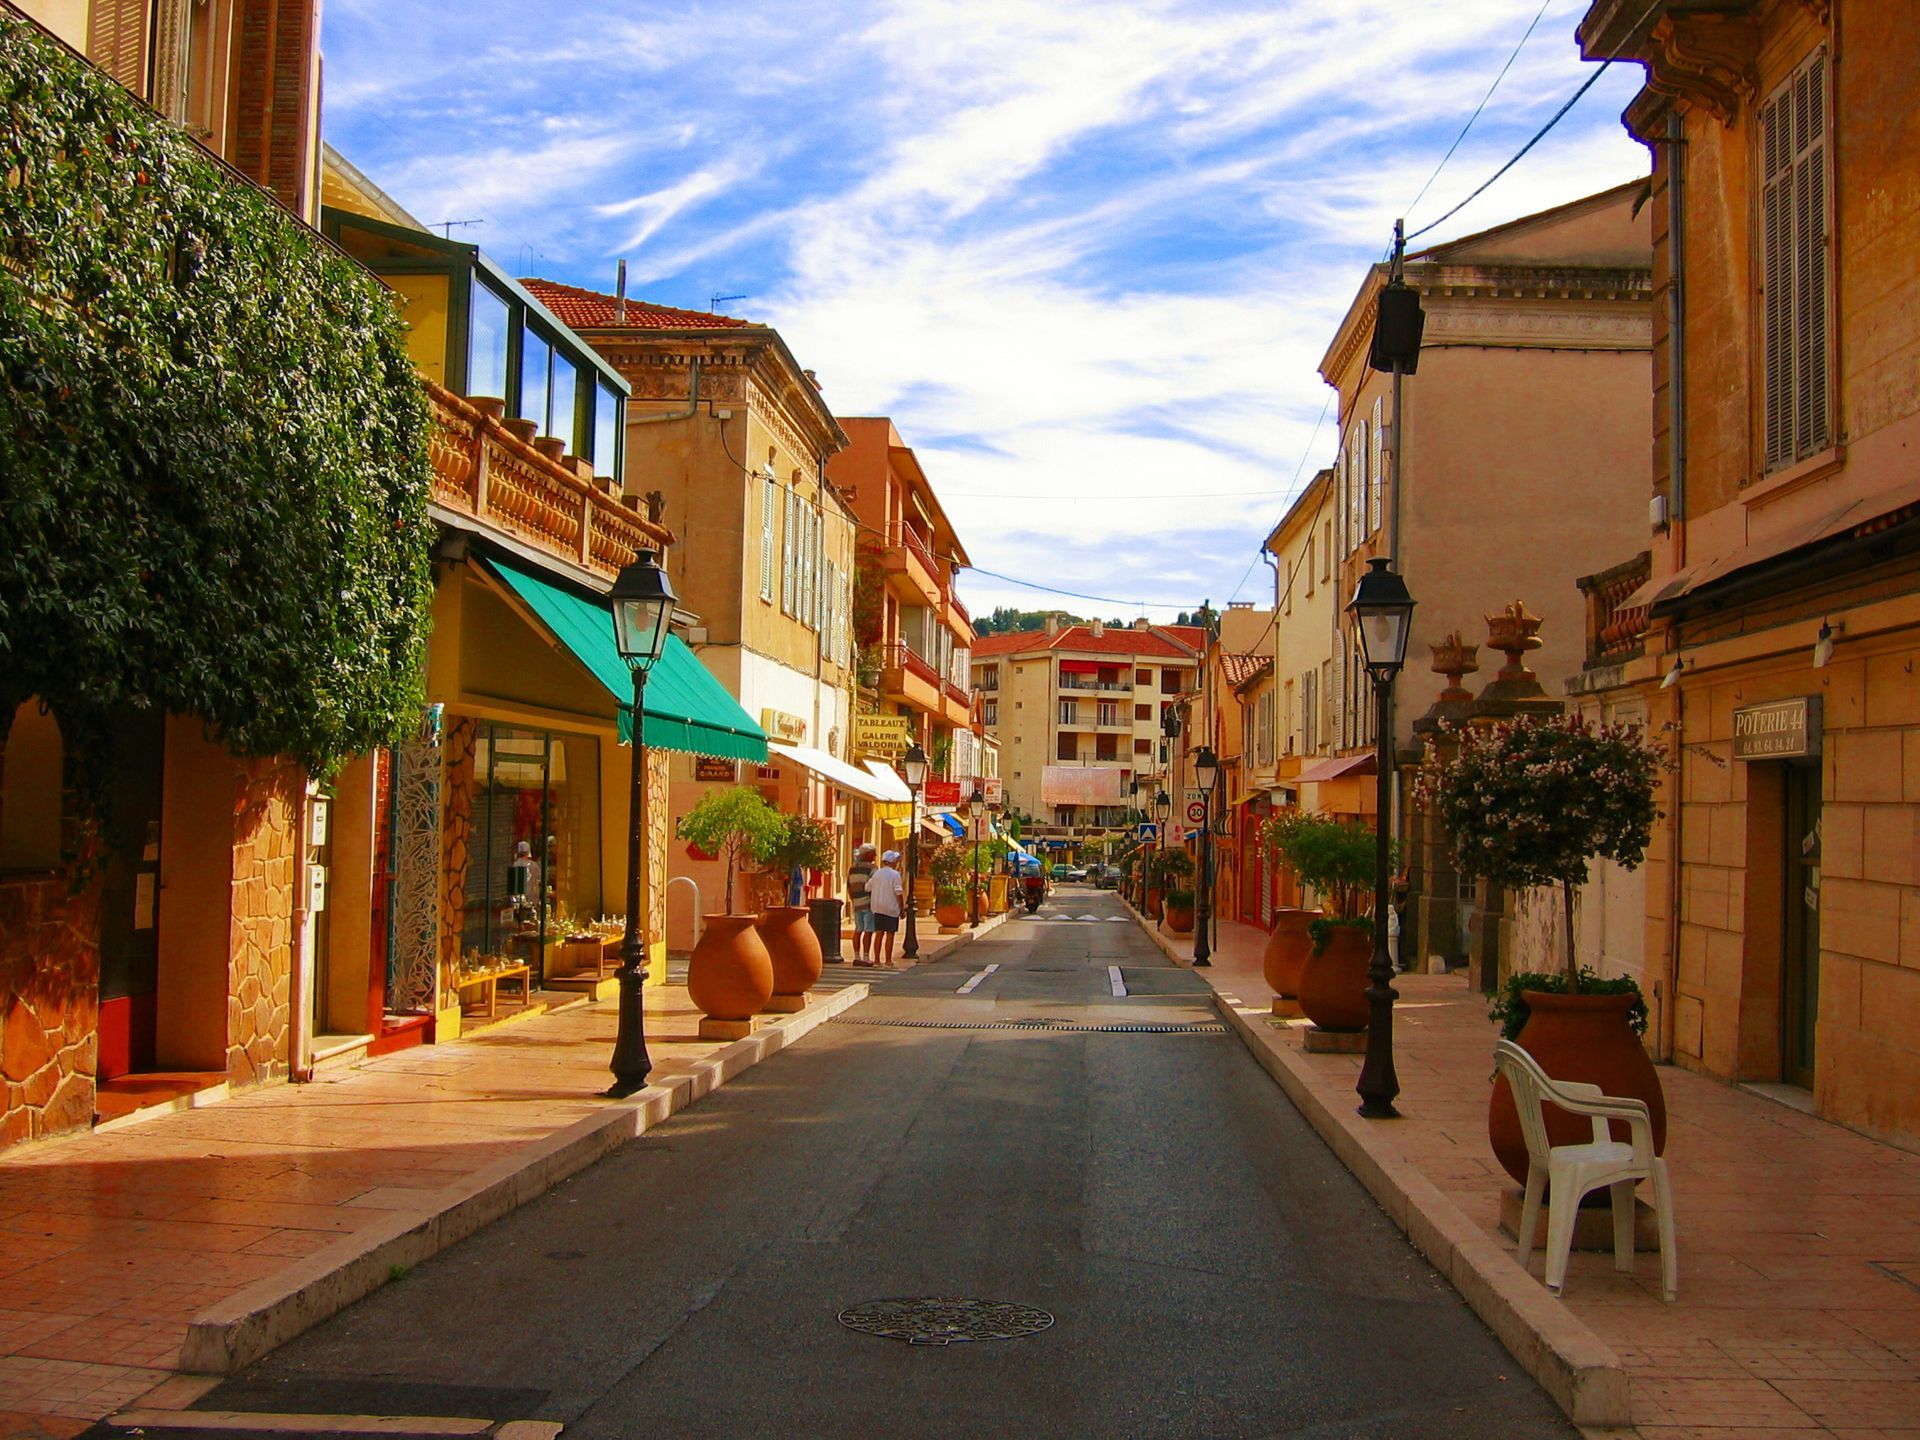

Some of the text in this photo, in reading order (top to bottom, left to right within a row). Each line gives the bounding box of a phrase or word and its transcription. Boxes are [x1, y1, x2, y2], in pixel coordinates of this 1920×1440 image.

[858, 719, 904, 727] TABLEAUX
[1735, 709, 1804, 736] POTERIE 44
[862, 732, 898, 740] GALERIE
[858, 741, 903, 749] VALDORIA
[1191, 808, 1203, 817] 30
